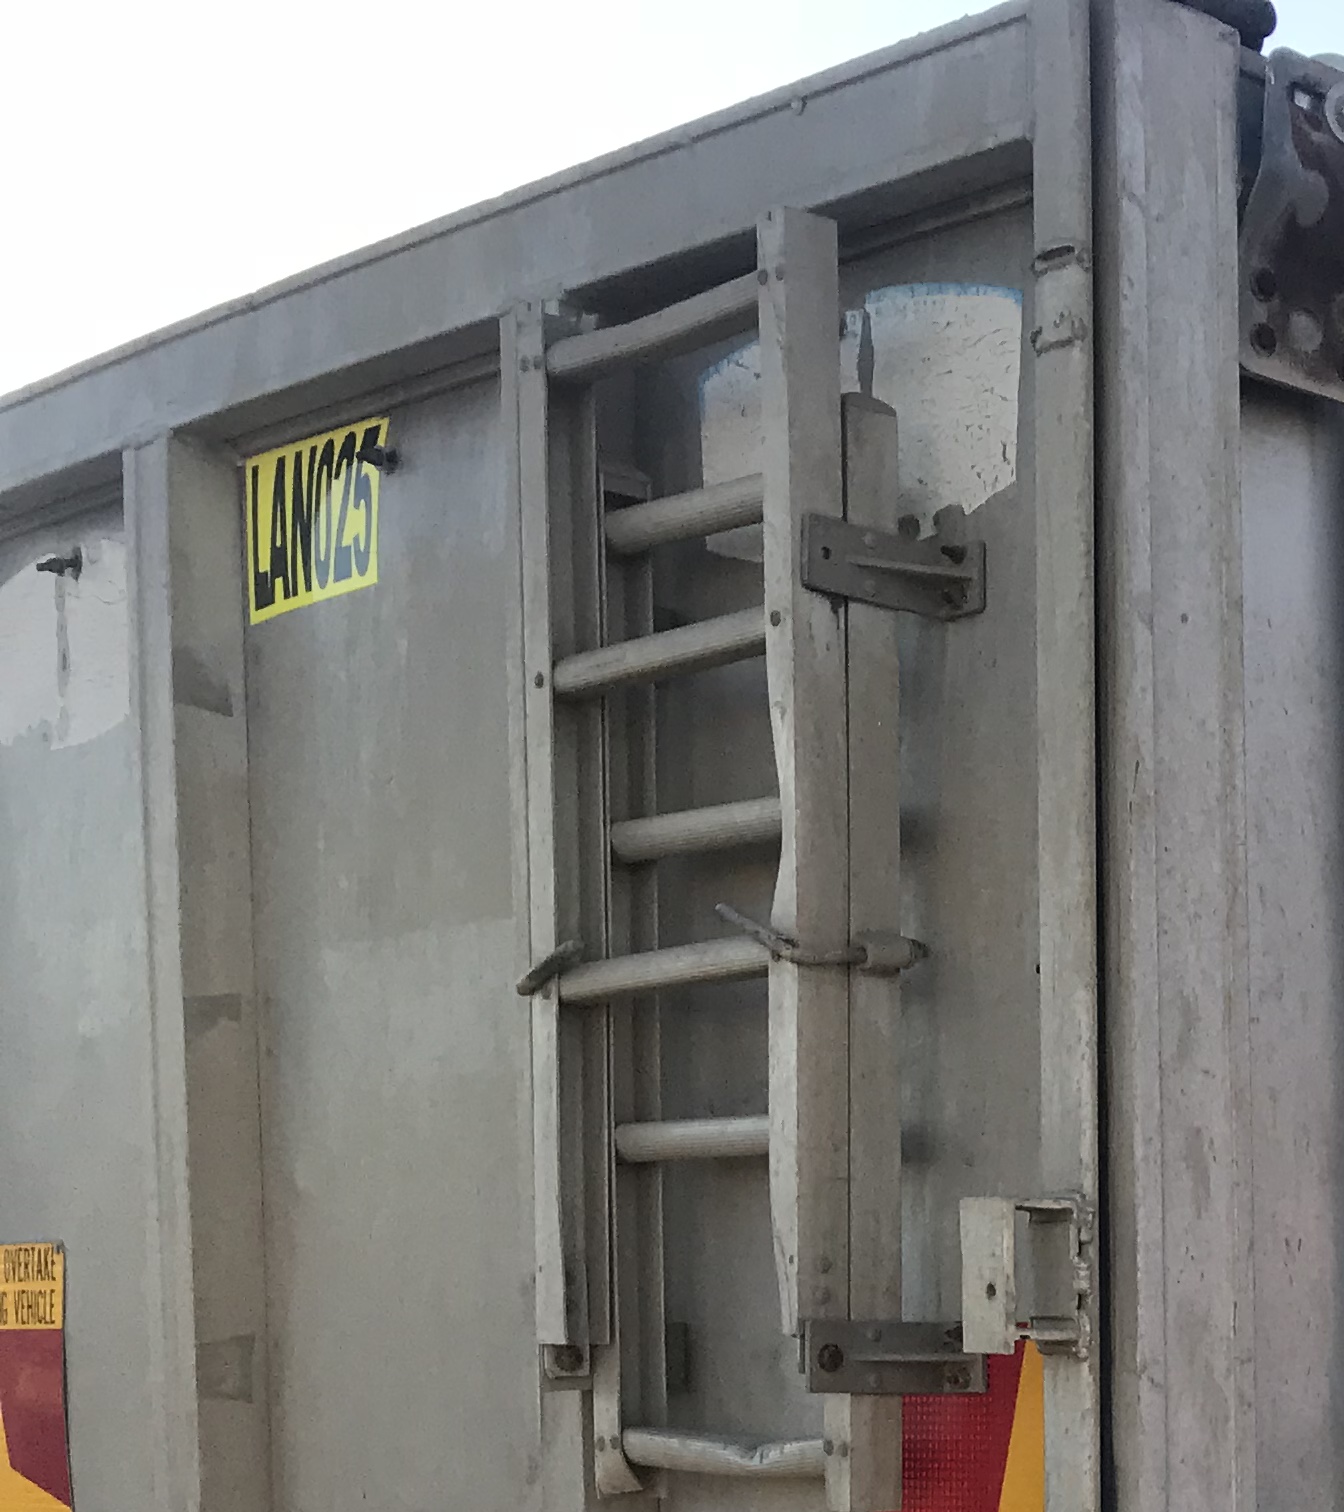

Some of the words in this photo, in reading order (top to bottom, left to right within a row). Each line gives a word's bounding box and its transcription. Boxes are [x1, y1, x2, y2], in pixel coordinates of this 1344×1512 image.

[251, 424, 382, 611] LAN025
[4, 1246, 56, 1282] OVERTAKE
[14, 1289, 55, 1325] VEHICLE
